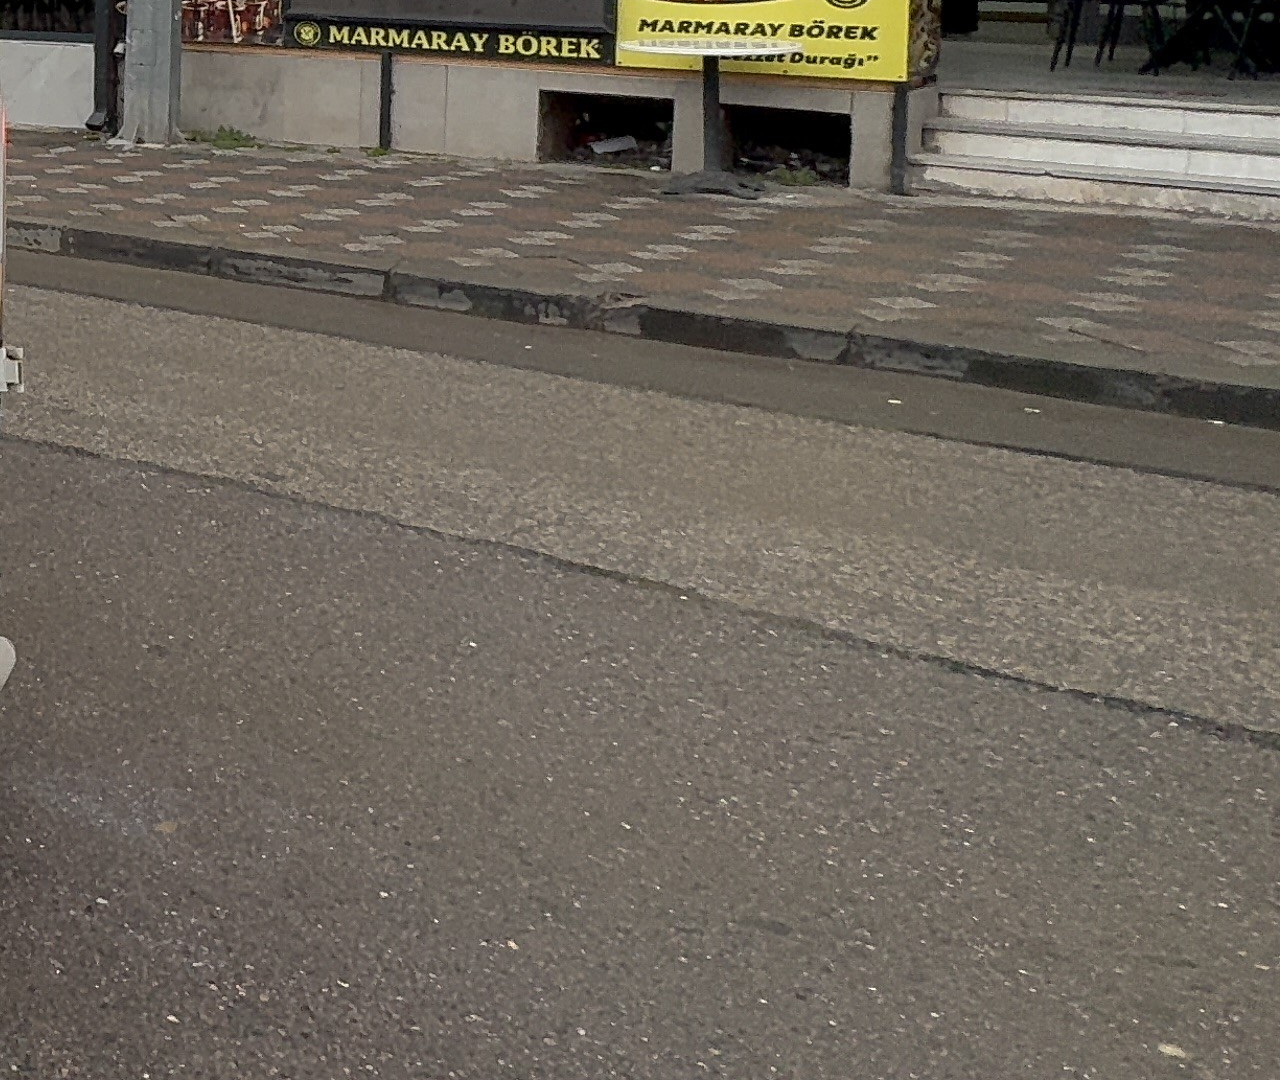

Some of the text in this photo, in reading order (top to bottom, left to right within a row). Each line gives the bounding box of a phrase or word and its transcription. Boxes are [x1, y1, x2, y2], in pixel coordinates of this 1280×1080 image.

[328, 24, 602, 59] MARMARAY BÖREK
[638, 18, 880, 41] MARMARAY BÖREK
